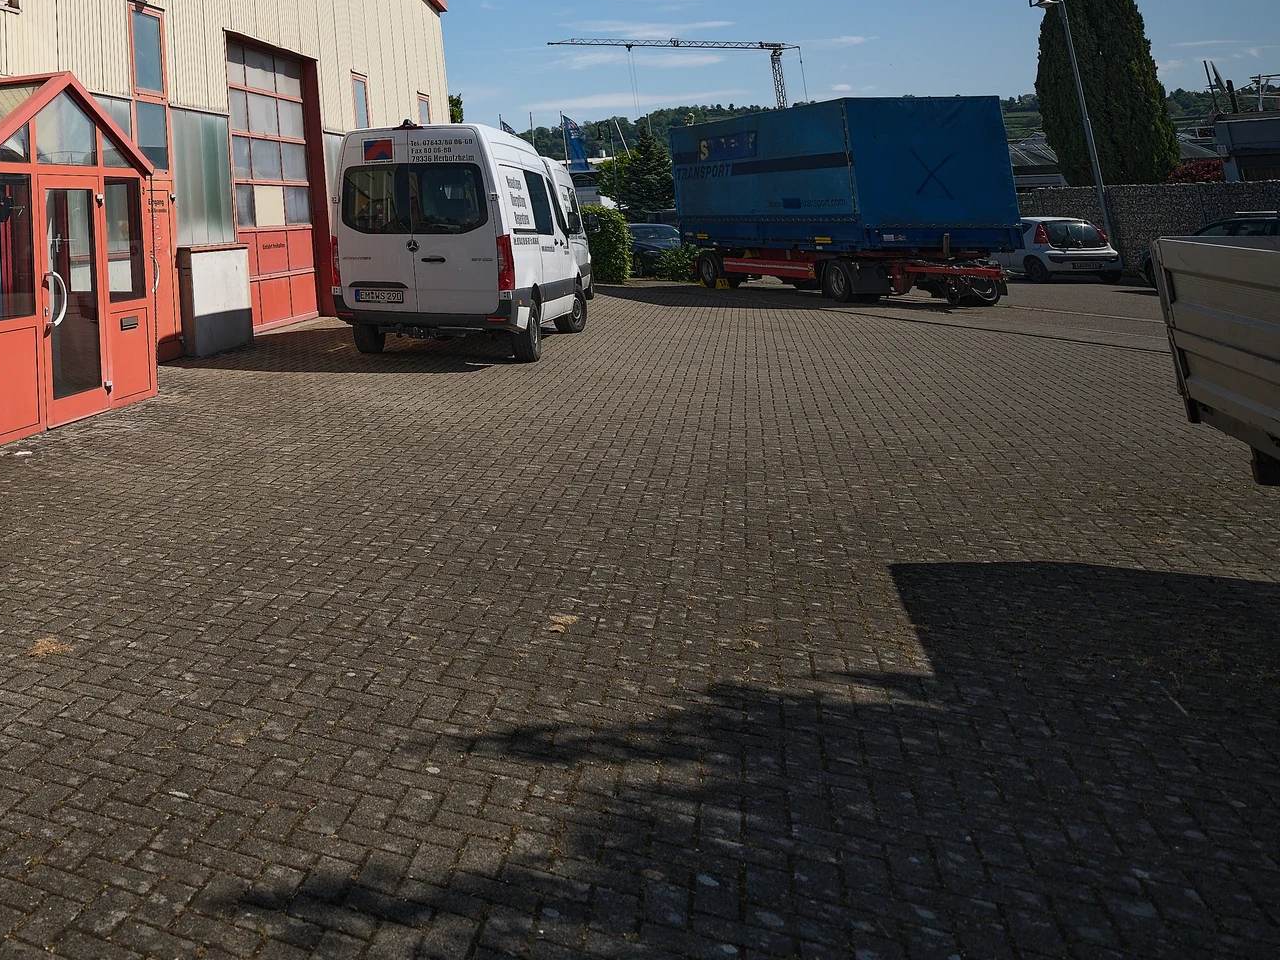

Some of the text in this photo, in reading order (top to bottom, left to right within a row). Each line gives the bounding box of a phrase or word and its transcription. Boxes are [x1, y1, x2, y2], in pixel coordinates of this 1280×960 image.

[676, 163, 732, 180] TRANSPORT
[360, 291, 370, 300] EM
[375, 291, 385, 300] WS
